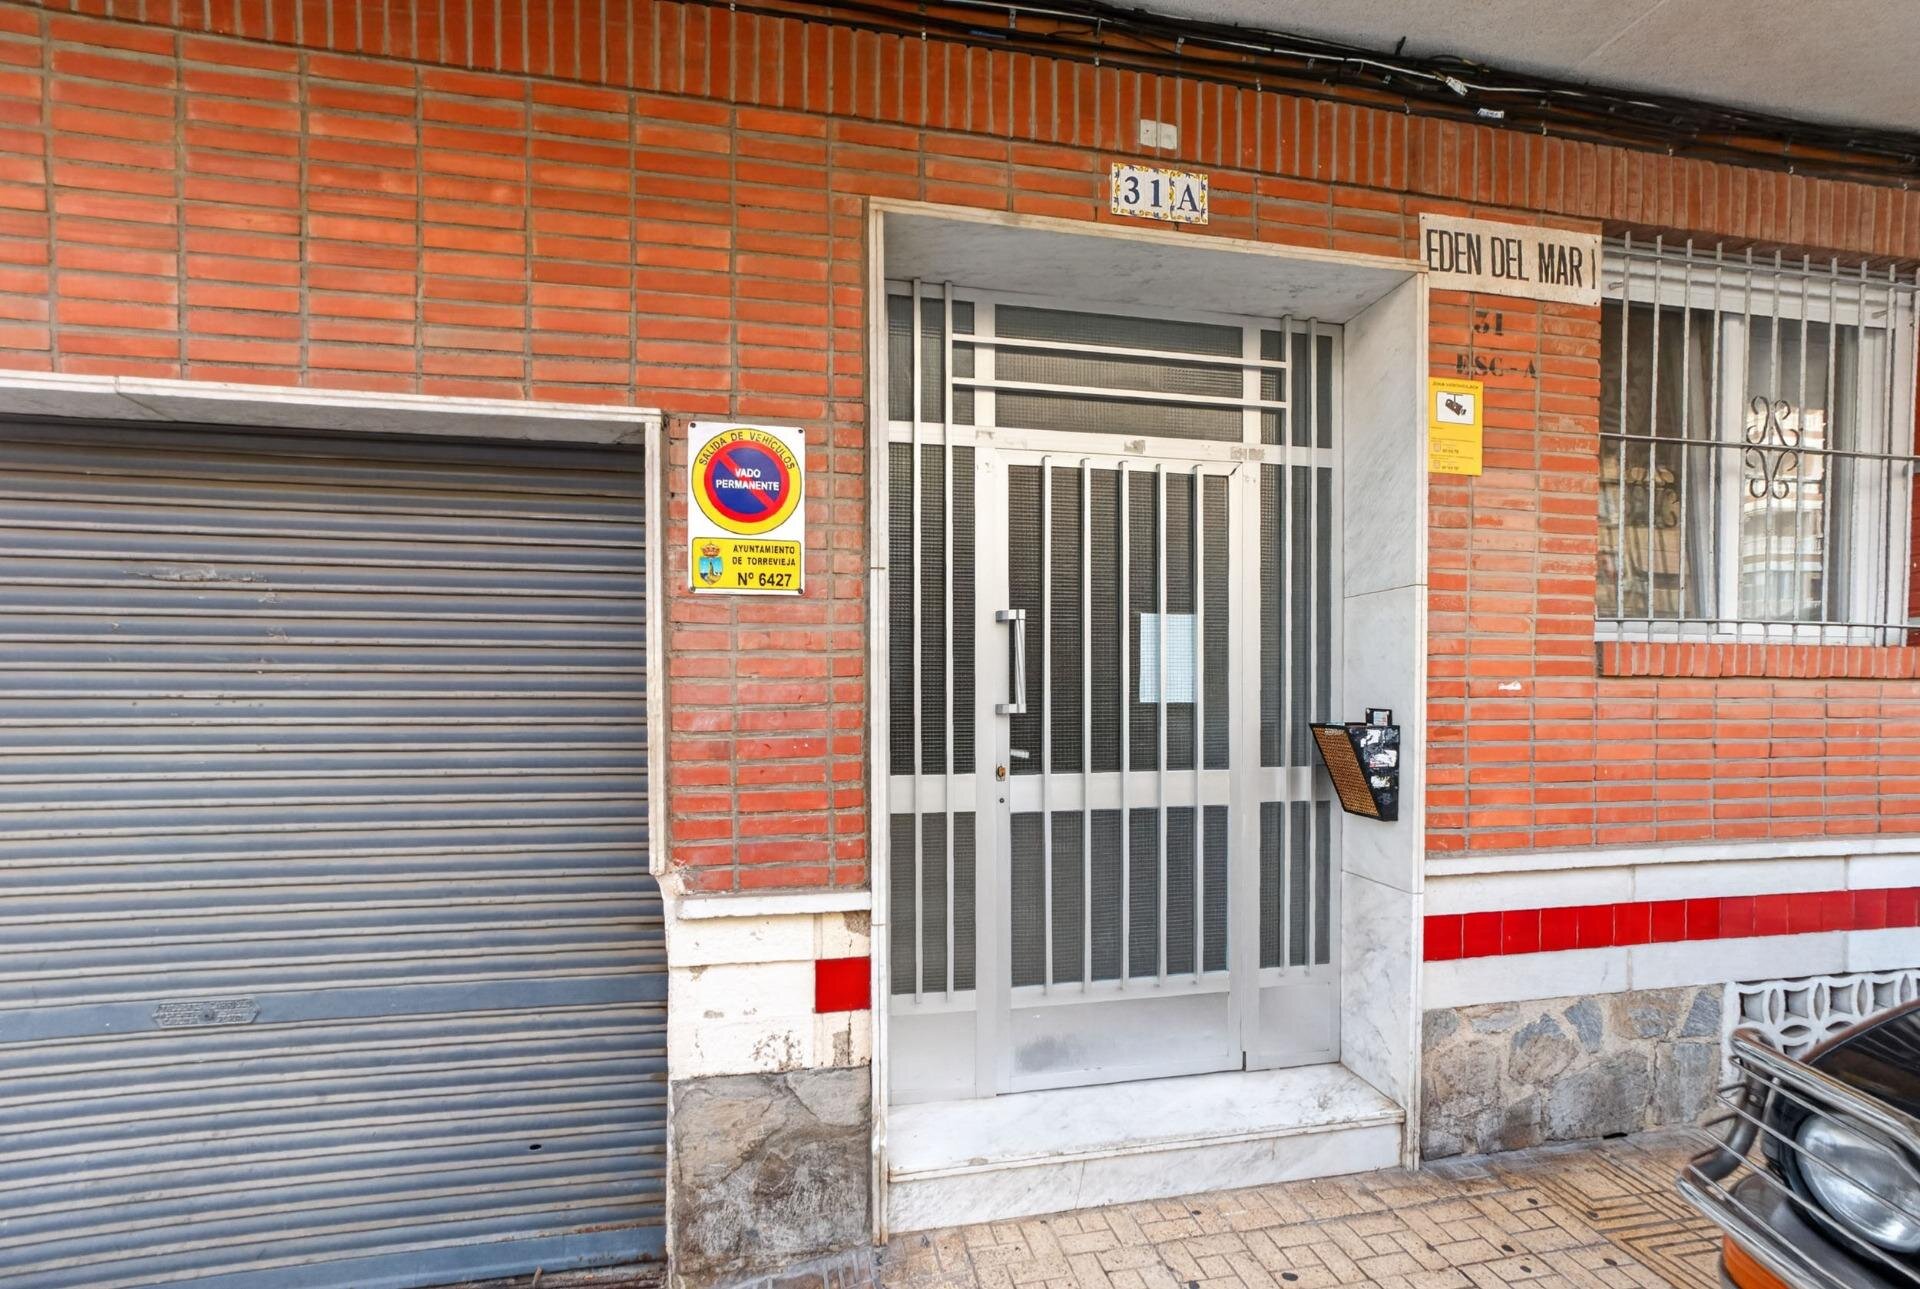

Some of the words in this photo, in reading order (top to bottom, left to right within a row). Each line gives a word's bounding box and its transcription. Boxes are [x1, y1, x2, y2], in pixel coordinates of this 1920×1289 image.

[1426, 229, 1482, 275] EDEN
[1491, 236, 1529, 281] DEL
[1538, 242, 1583, 288] MAR
[1474, 310, 1504, 336] 31
[699, 437, 727, 465] SALIDA
[730, 431, 744, 441] DE
[735, 468, 761, 478] VADO
[715, 479, 780, 491] PERMANENTE
[733, 545, 795, 554] AYUNTAMIENTO
[732, 556, 742, 565] DE
[747, 557, 795, 566] TORREVIEJA
[759, 573, 792, 587] 6427
